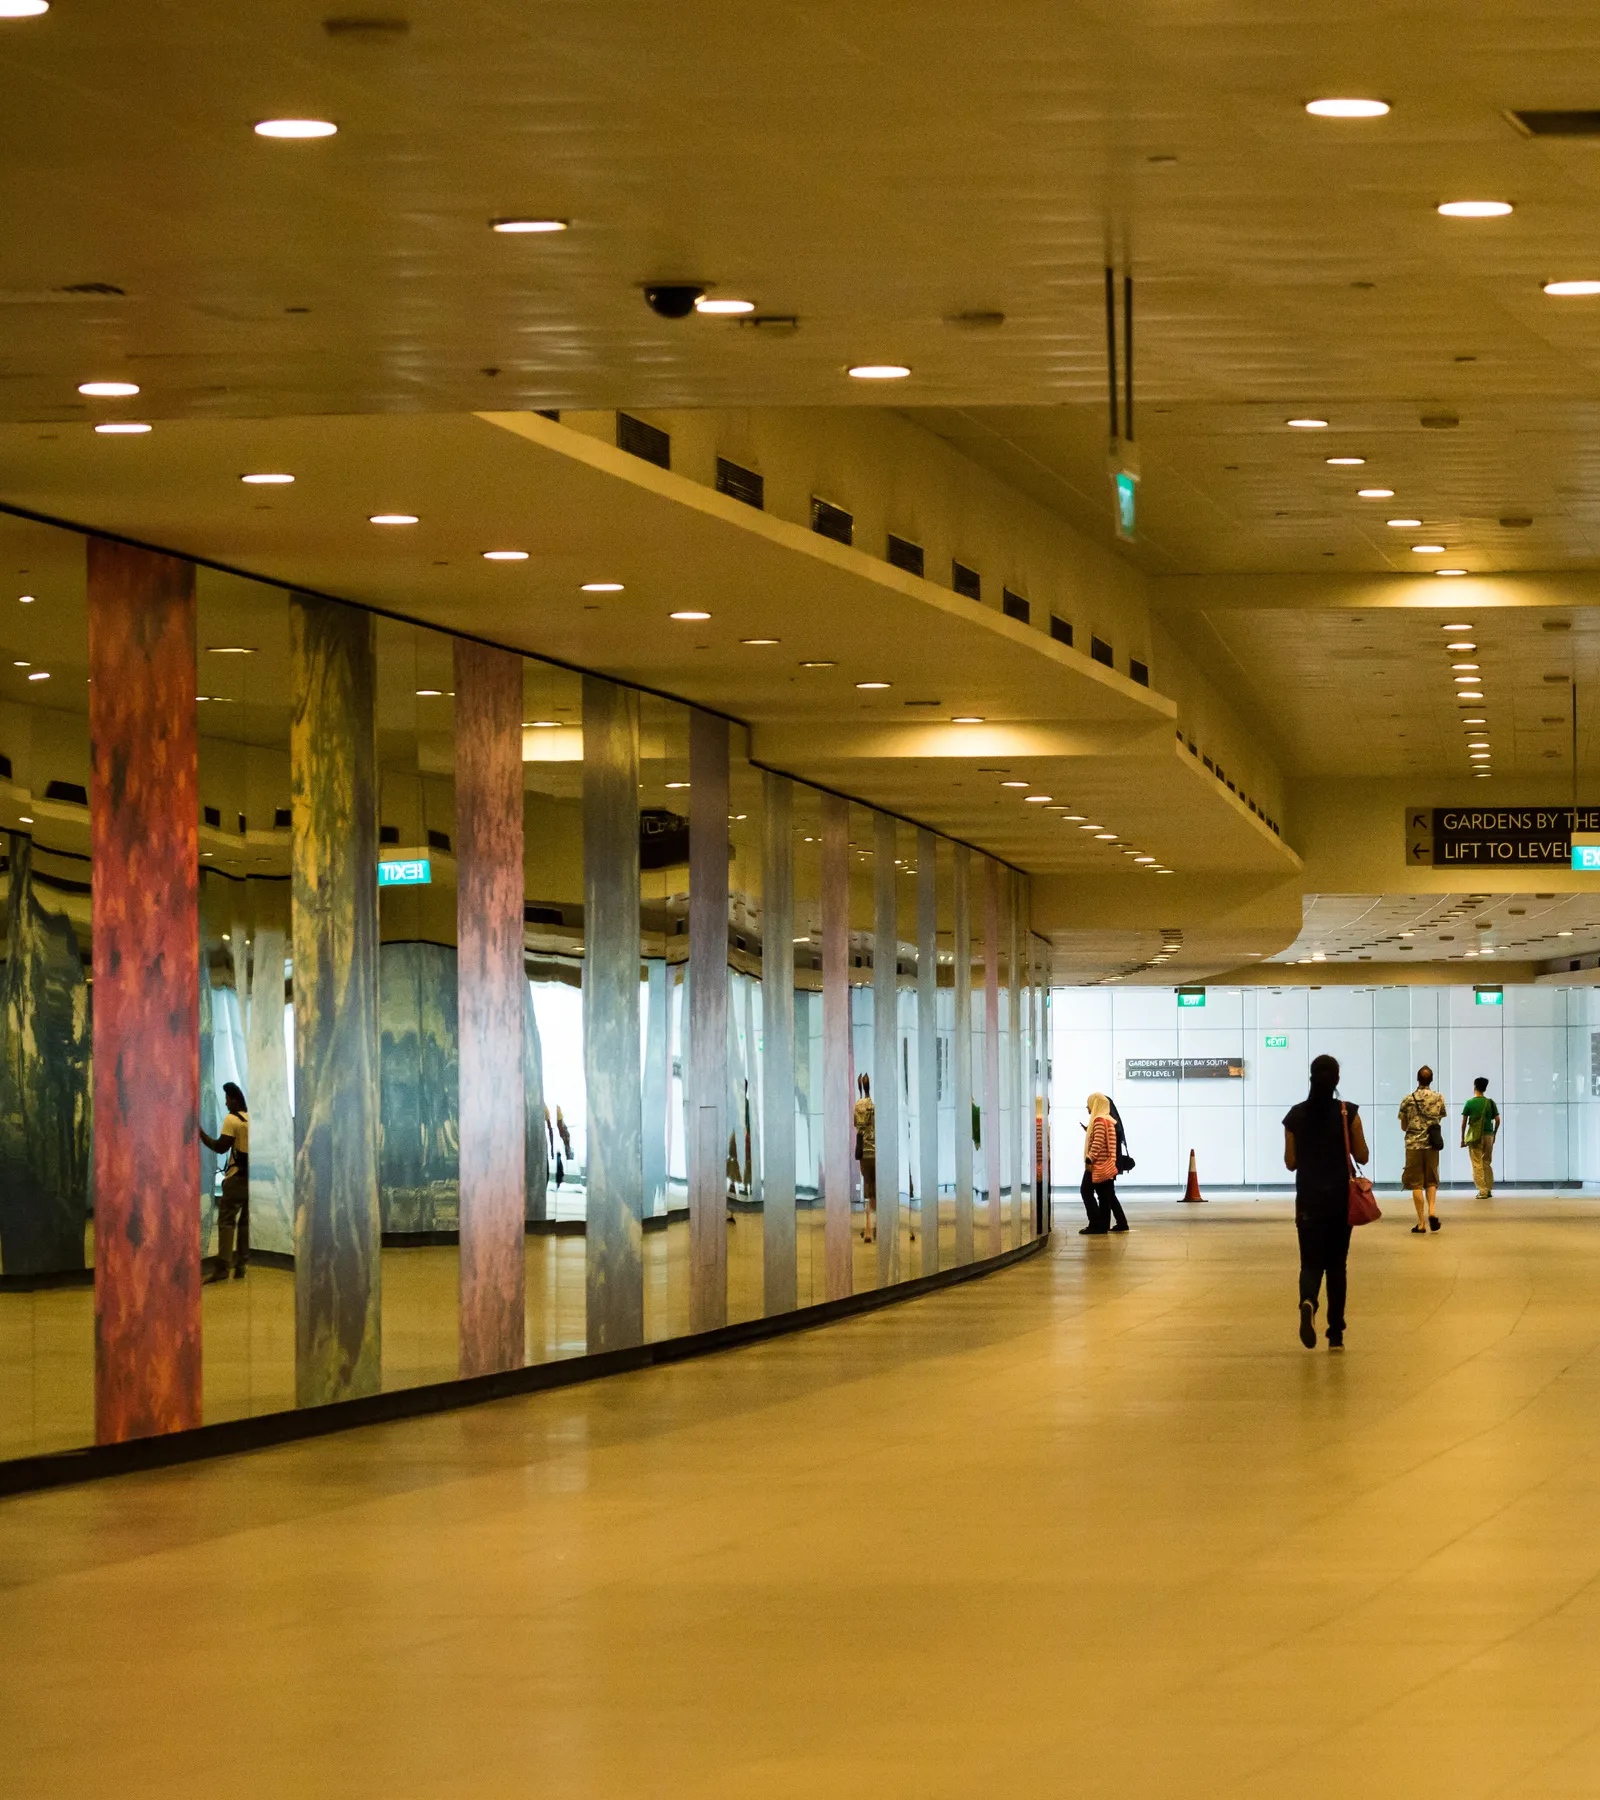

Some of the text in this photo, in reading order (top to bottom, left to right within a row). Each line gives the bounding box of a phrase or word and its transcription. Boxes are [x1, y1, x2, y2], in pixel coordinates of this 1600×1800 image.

[1443, 813, 1532, 830] GARDENS
[1537, 813, 1558, 829] BY
[1563, 812, 1600, 829] THE
[1445, 842, 1572, 859] LIFT TO LEVEL
[1183, 996, 1200, 1005] EXIT
[1270, 1038, 1286, 1047] EXIT
